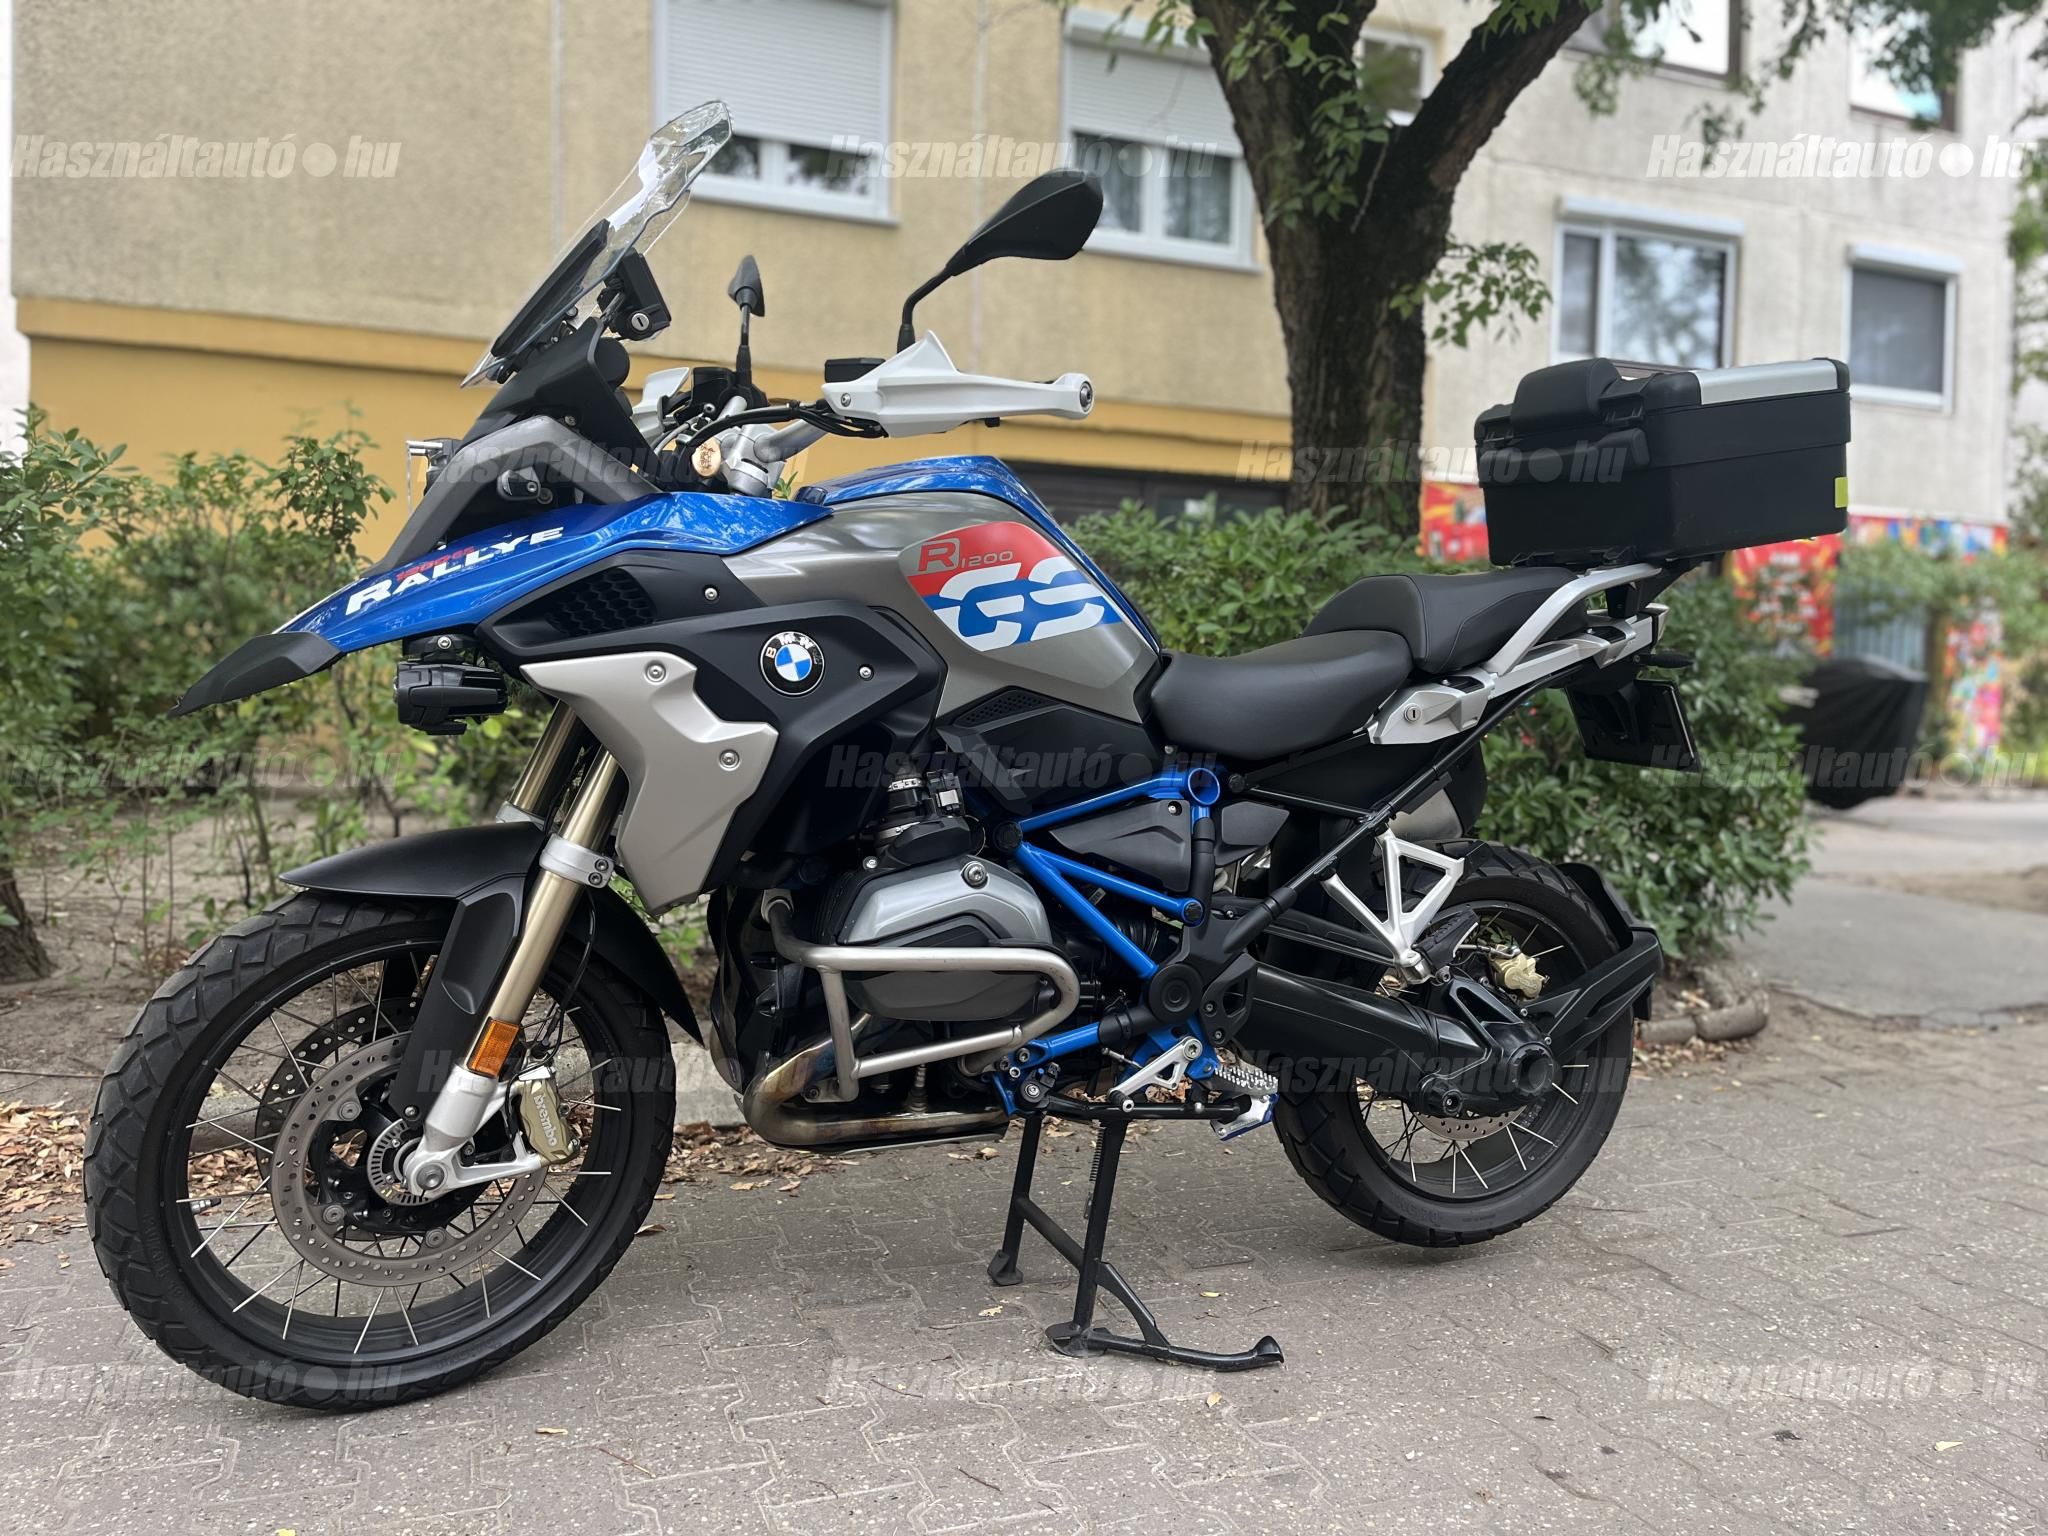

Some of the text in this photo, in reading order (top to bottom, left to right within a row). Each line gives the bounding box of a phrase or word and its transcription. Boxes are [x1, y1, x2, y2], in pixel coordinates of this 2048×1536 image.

[345, 526, 565, 616] RALLYE
[961, 551, 1014, 569] 1200
[934, 556, 1104, 652] GS
[764, 631, 816, 659] BMW
[533, 1094, 558, 1147] brembo
